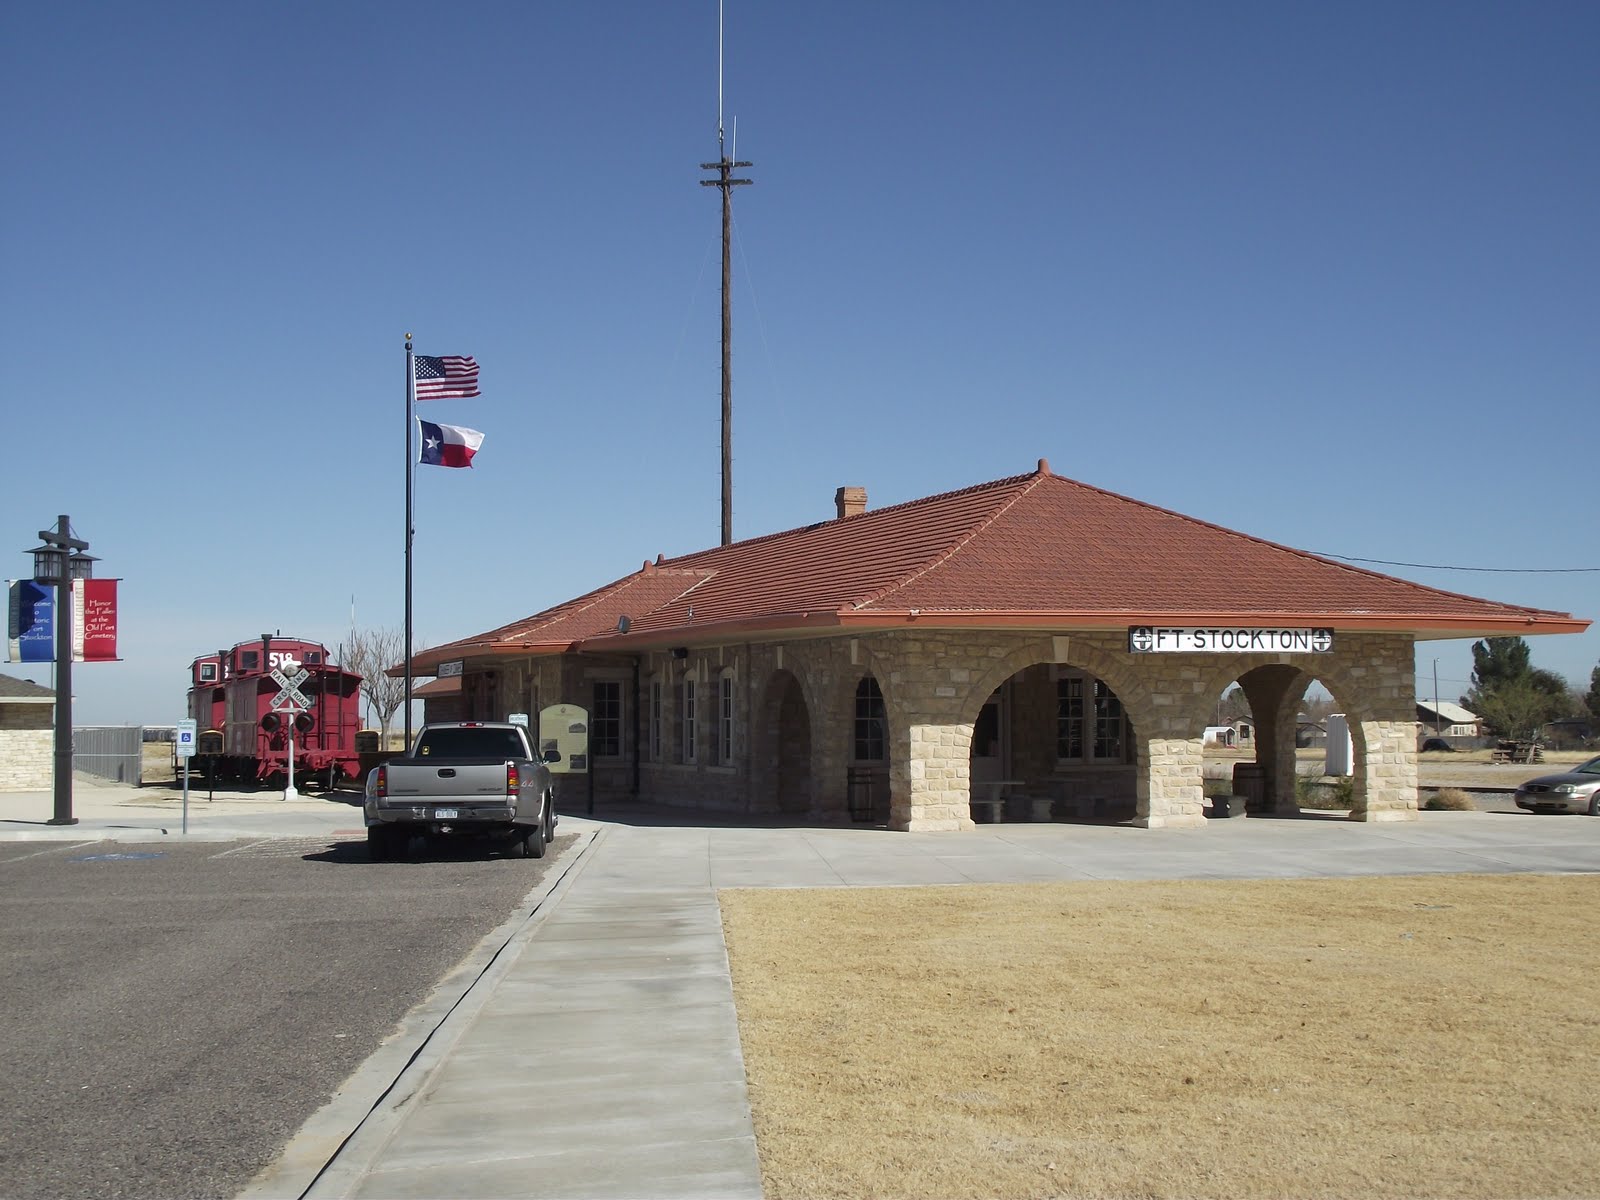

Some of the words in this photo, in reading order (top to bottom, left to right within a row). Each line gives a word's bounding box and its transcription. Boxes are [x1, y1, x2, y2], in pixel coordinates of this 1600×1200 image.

[85, 623, 99, 632] Old
[99, 623, 115, 631] Fort
[19, 633, 52, 642] Stockton
[84, 631, 116, 641] Cemetery
[271, 670, 286, 686] RAIL
[292, 691, 308, 707] ROAD
[272, 671, 307, 706] CROSSING
